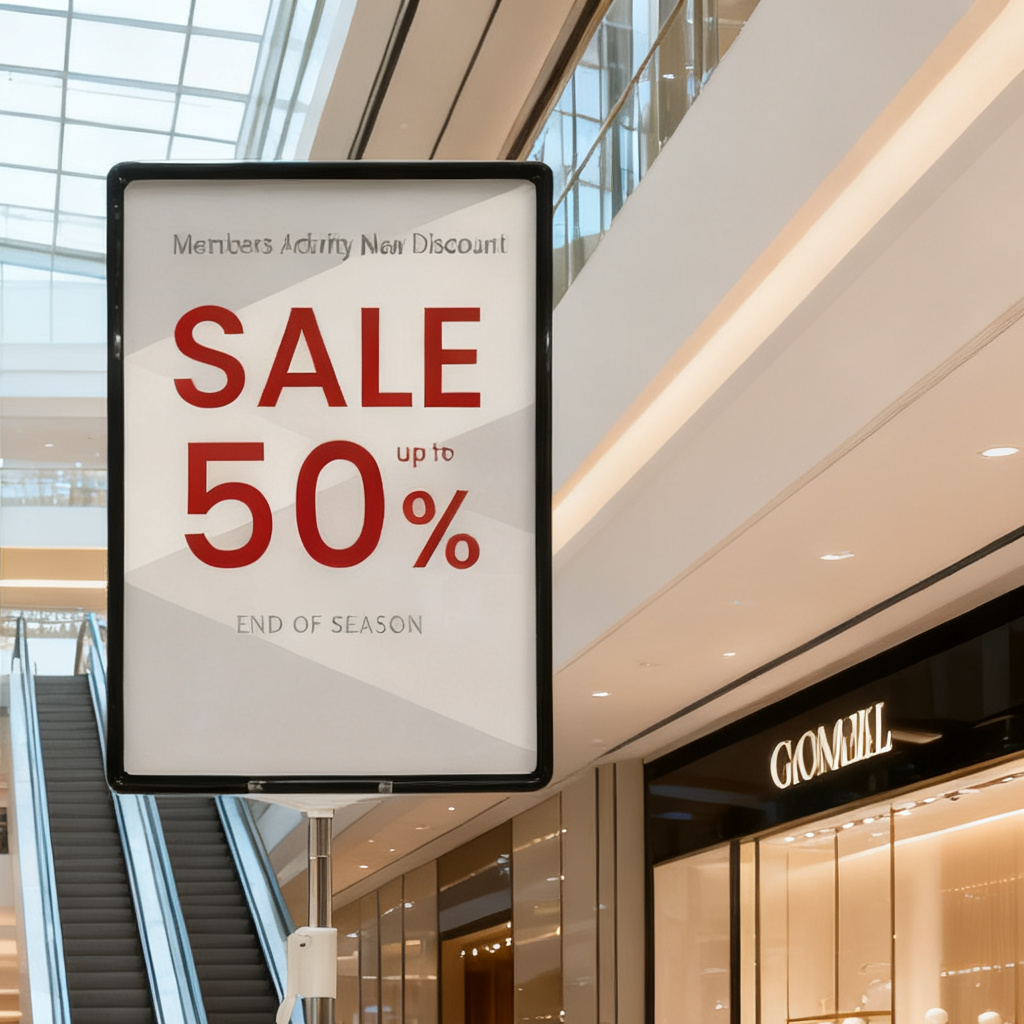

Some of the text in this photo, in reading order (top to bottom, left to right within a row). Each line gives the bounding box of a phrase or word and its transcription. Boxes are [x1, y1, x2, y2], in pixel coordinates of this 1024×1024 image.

[175, 305, 481, 408] SALE
[236, 615, 423, 634] END OF SEASON
